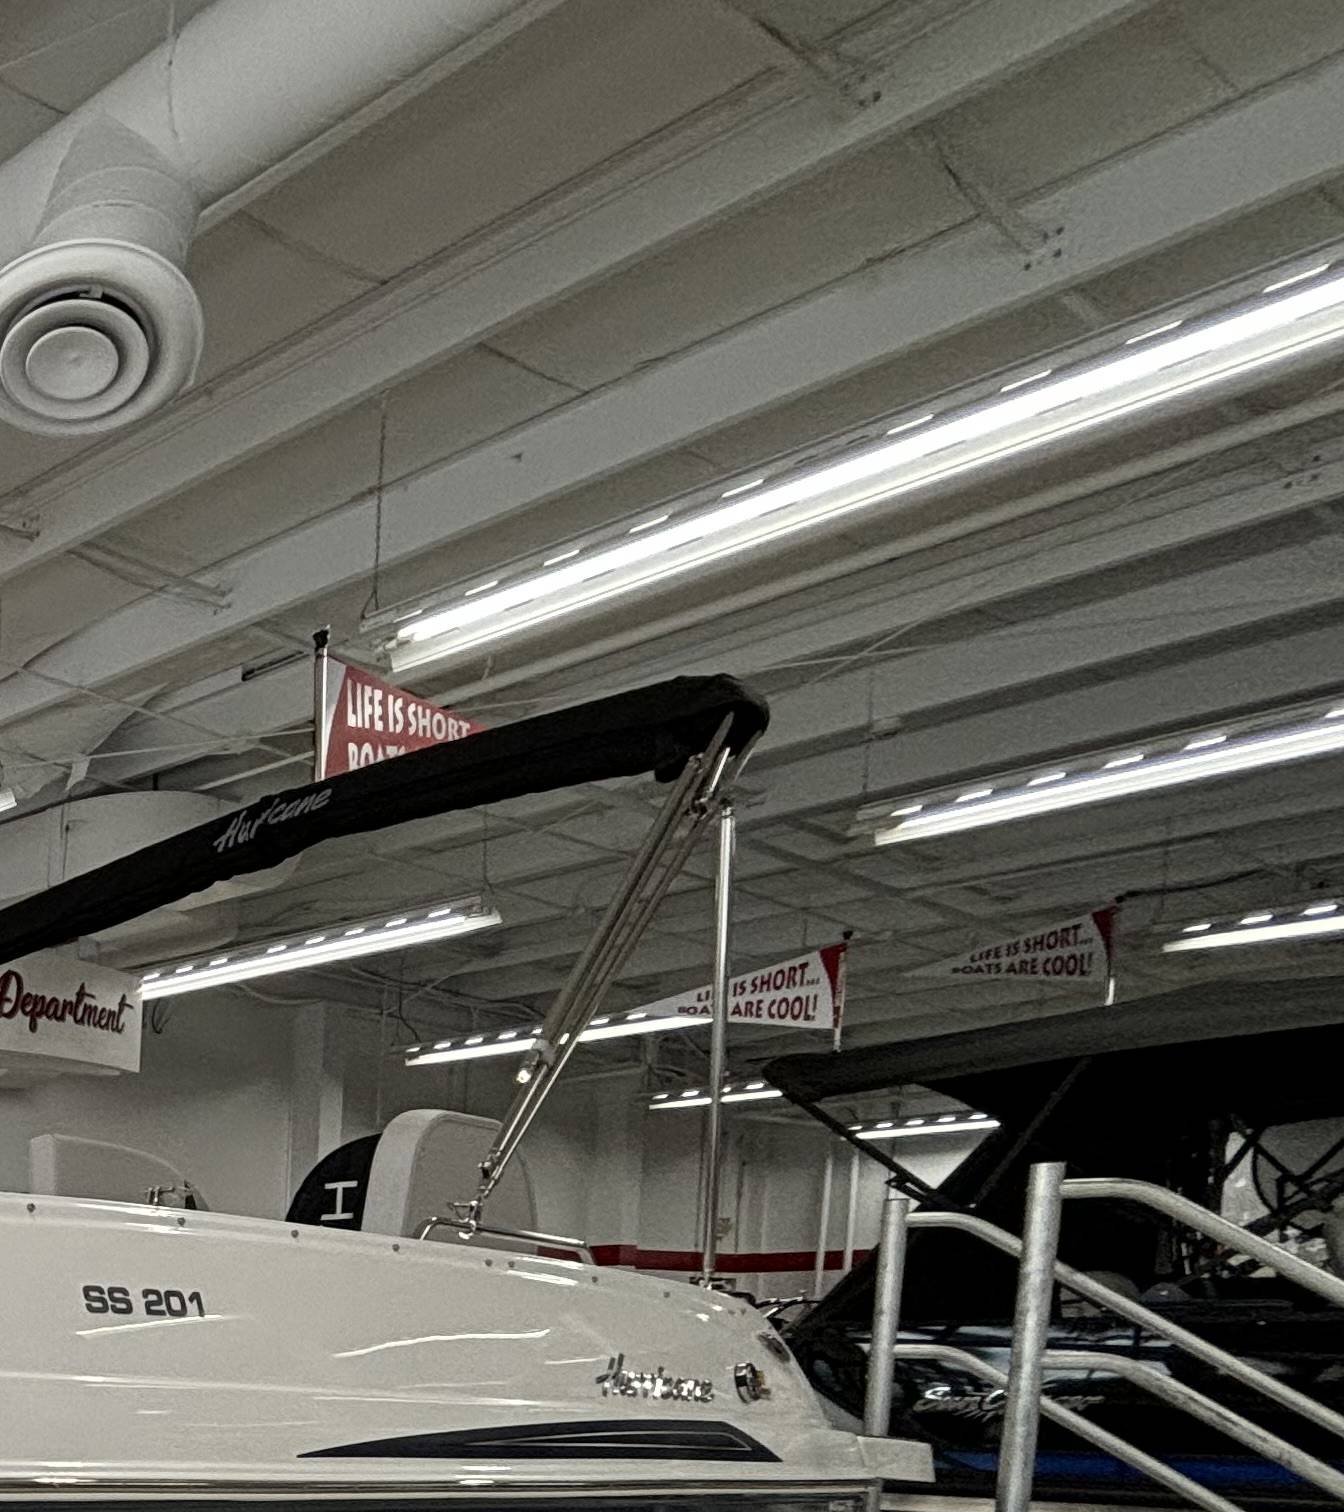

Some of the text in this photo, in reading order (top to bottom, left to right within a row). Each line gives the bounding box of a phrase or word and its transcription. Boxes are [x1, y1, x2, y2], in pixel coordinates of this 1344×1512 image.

[347, 678, 384, 733] LIFE
[388, 694, 404, 734] IS
[952, 952, 1094, 977] BOATS ARE COOL!
[969, 947, 1004, 964] LIFE
[1006, 940, 1021, 956] IS
[732, 979, 747, 998] IS
[730, 1000, 764, 1019] ARE
[767, 993, 819, 1022] COOL!
[82, 1285, 206, 1318] SS 201
